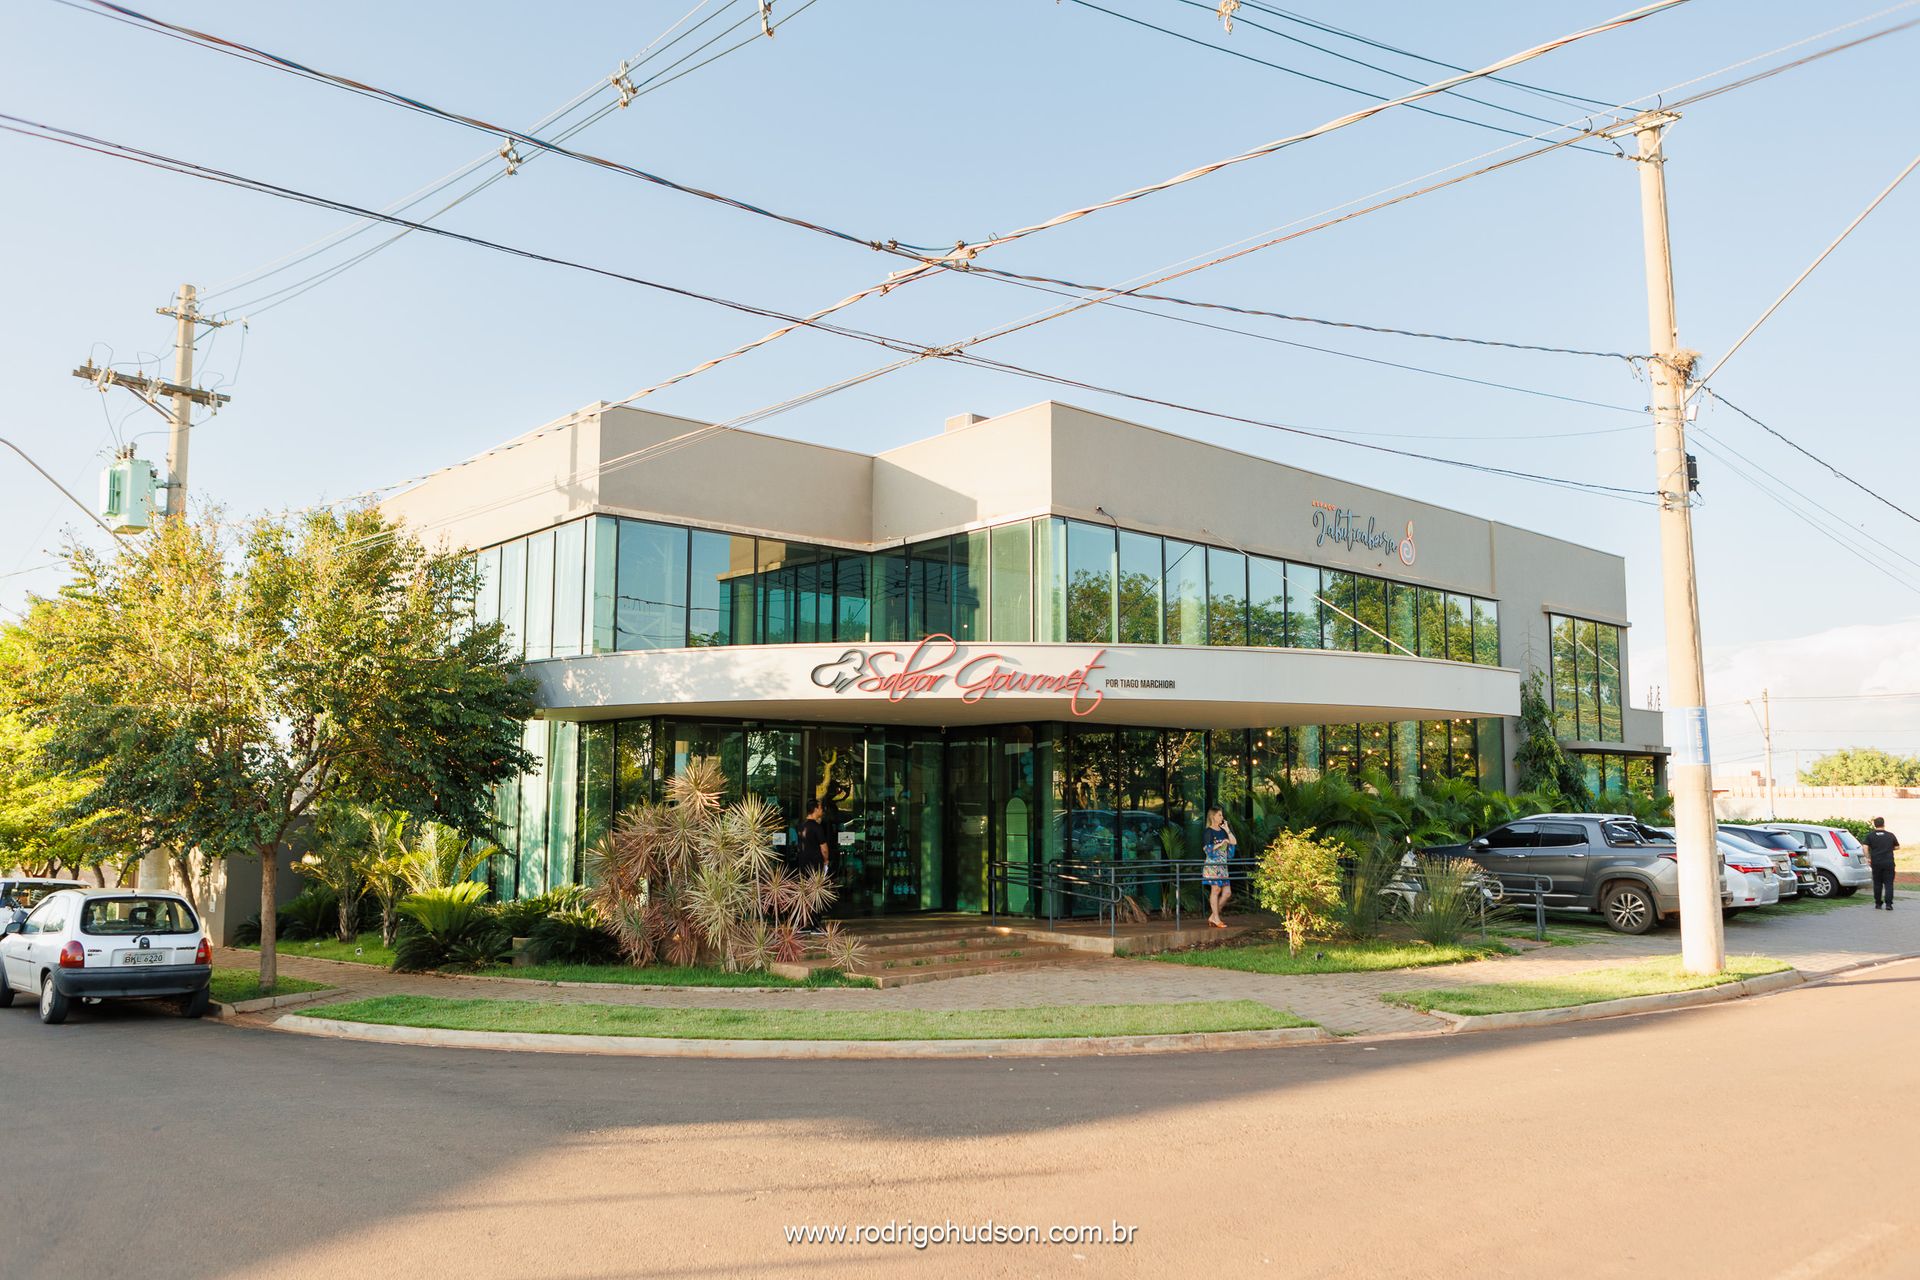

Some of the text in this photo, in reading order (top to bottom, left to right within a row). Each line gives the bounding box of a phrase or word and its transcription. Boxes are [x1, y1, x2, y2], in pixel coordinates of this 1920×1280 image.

[858, 633, 1106, 716] Sabor Gourmet
[1105, 679, 1176, 689] POR TIAGO MARCHIORI
